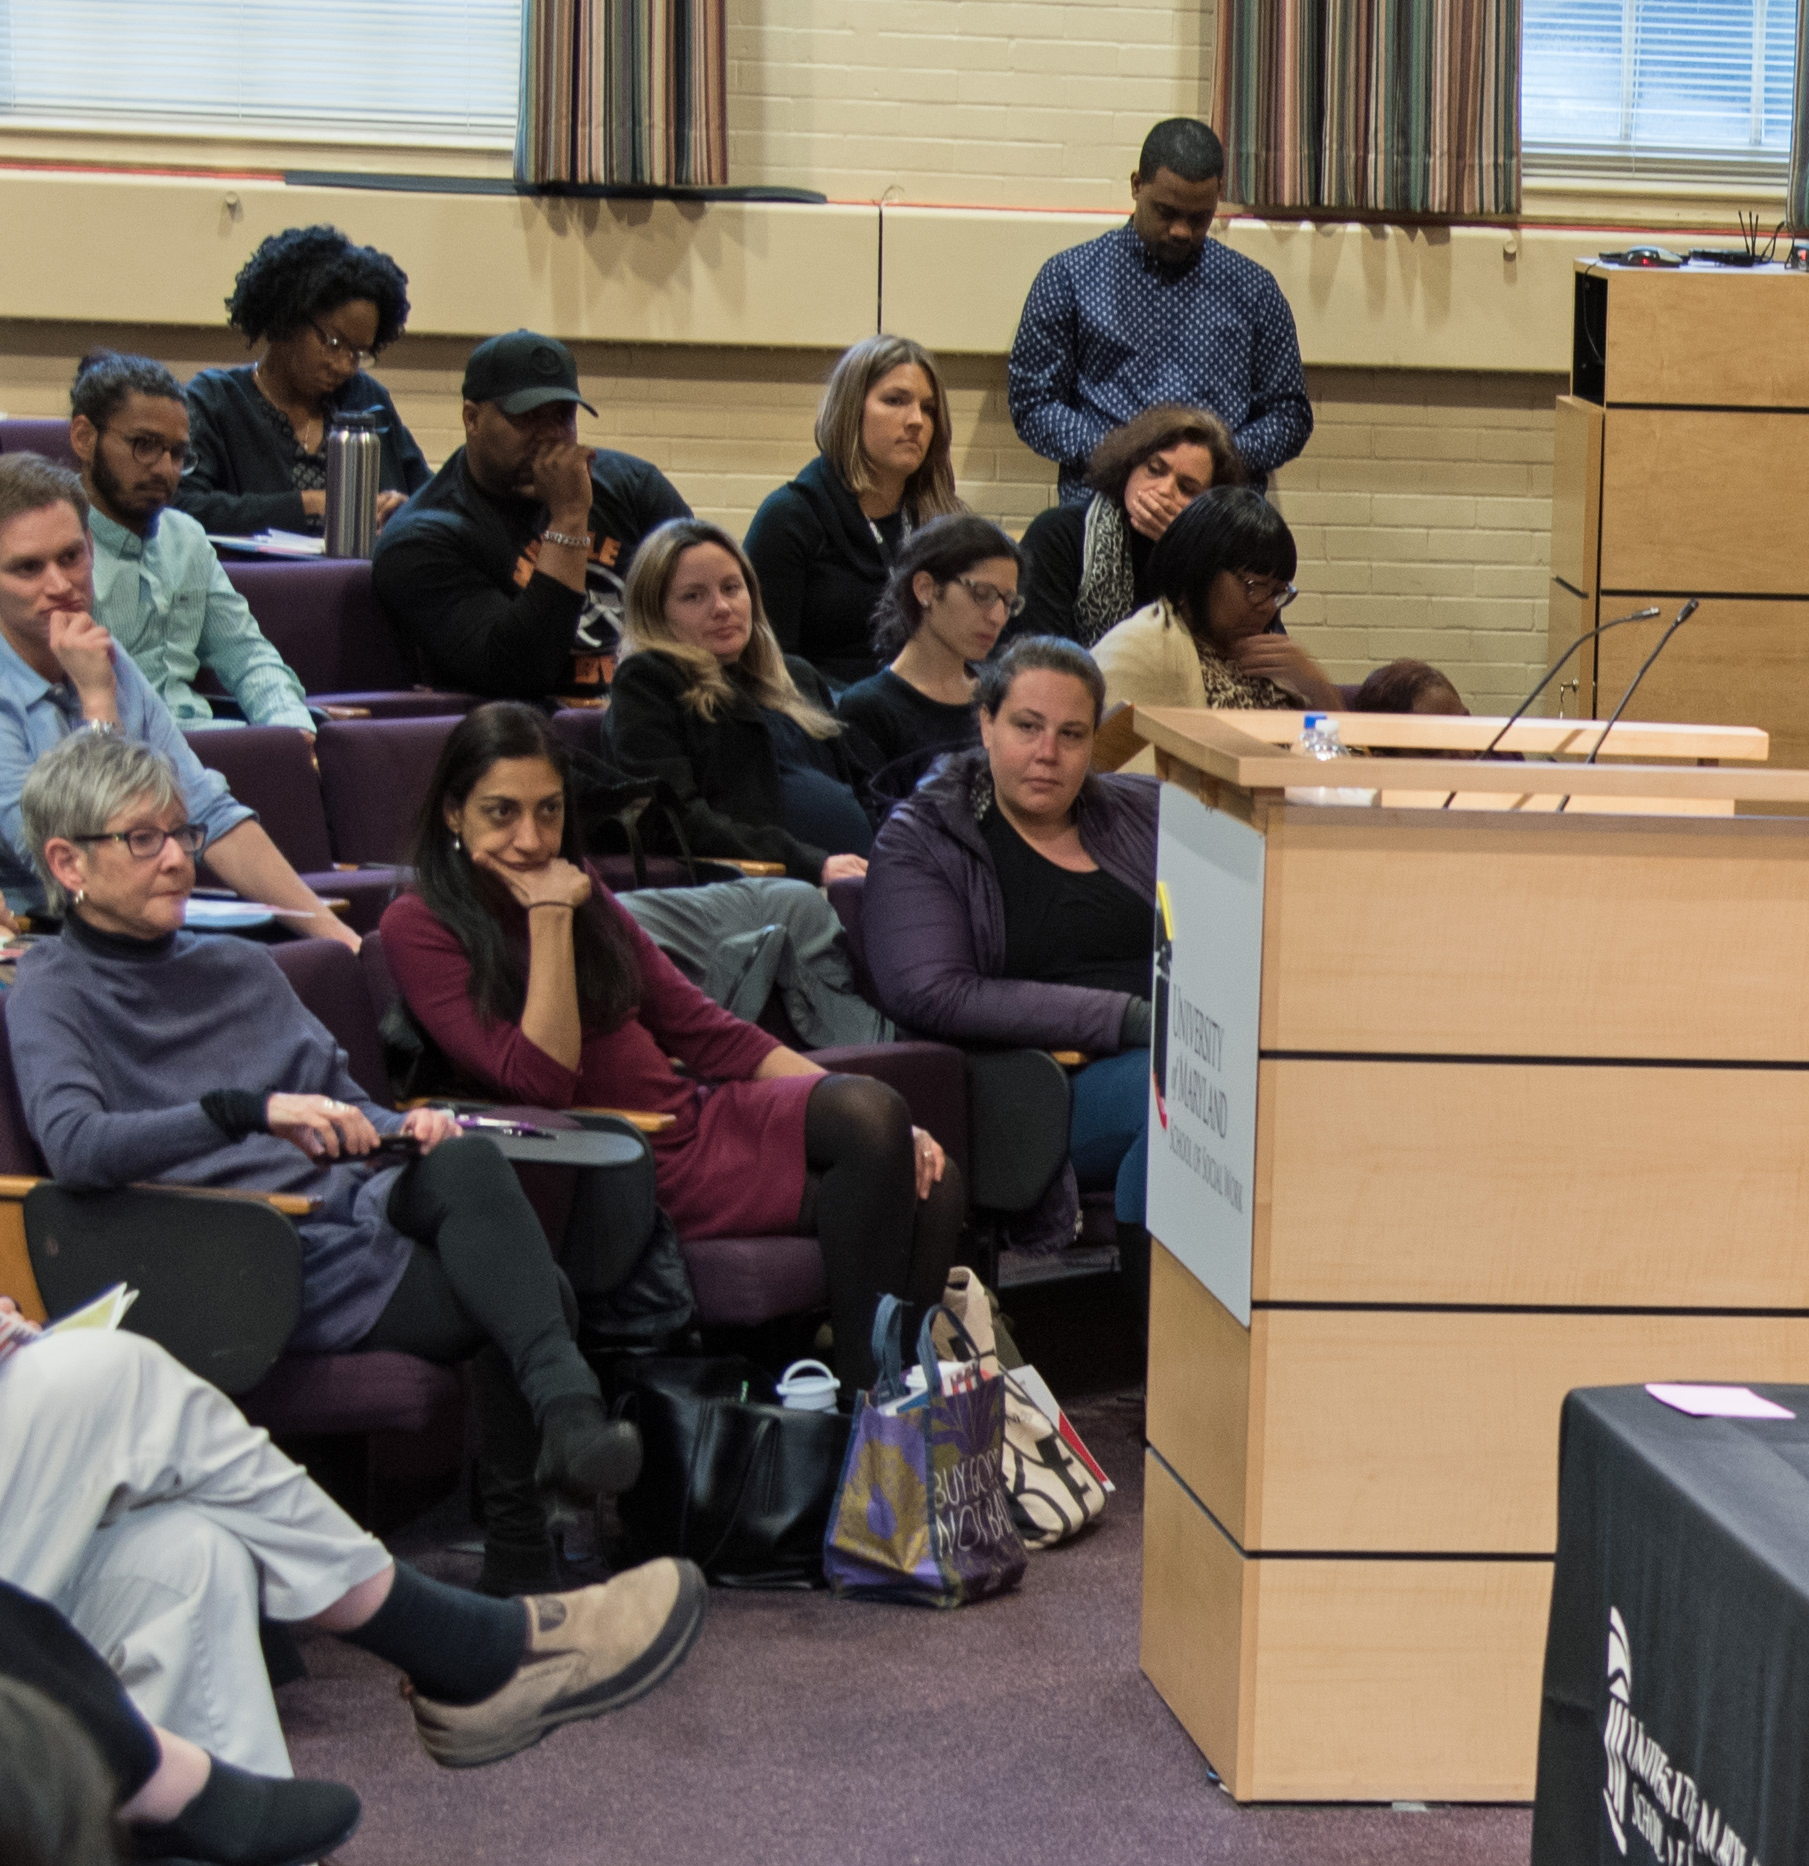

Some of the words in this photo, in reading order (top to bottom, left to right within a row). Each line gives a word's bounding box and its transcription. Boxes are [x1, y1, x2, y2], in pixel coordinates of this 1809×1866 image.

[1173, 983, 1225, 1072] UNIVERSITY
[1177, 1053, 1227, 1139] MARYLAND
[933, 1462, 967, 1509] BUY
[936, 1500, 988, 1557] NOT
